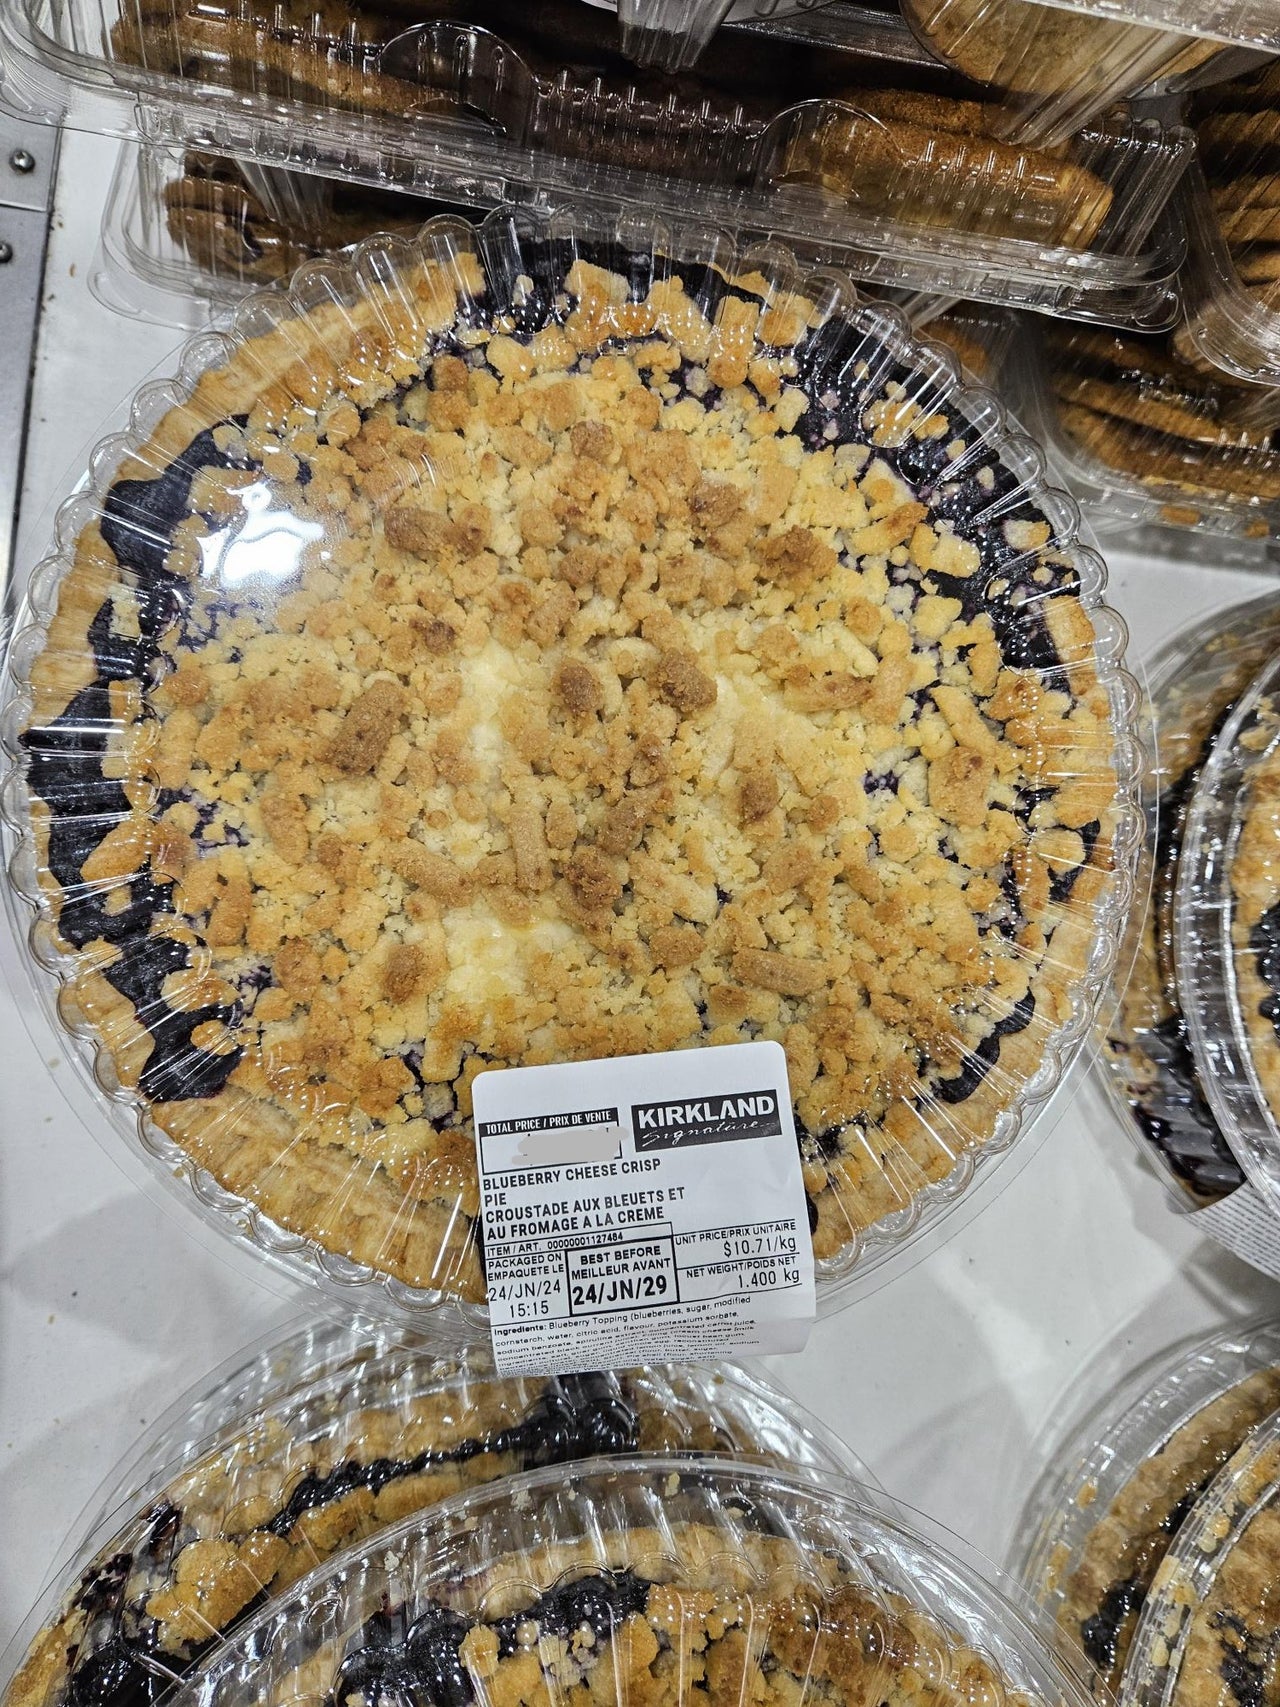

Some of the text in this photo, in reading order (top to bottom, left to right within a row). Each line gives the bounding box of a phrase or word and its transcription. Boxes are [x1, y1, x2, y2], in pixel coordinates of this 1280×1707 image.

[486, 1110, 611, 1134] TOTAL PRICE / PRIX DE VENTE
[638, 1096, 774, 1128] KIRKLAND
[642, 1120, 772, 1146] Signature
[483, 1158, 660, 1190] BLUEBERRY CHEESE CRISP
[485, 1193, 506, 1207] PIE
[486, 1187, 684, 1223] CROUSTADE AUX BLEUETS ET
[487, 1206, 664, 1240] AU FROMAGE A LA CREME
[676, 1222, 796, 1245] UNIT PRICE/PRIX UNITAIRE
[487, 1246, 510, 1257] ITEM
[518, 1242, 541, 1253] ART.
[580, 1246, 660, 1265] BEST BEFORE
[724, 1235, 796, 1258] $10.71/kg
[489, 1253, 562, 1269] PACKAGED ON
[571, 1258, 670, 1280] MEILLEUR AVANT
[687, 1256, 796, 1278] NET WEIGHT/POIDS NET
[488, 1264, 564, 1281] EMPAQUETE LE
[739, 1268, 799, 1288] 1.400 kg
[489, 1279, 560, 1301] 24/JN/24
[572, 1275, 667, 1305] 24/JN/29
[495, 1324, 547, 1336] Ingredients:
[549, 1318, 589, 1330] Blueberry
[593, 1313, 627, 1324] Topping
[714, 1297, 750, 1308] modified
[510, 1301, 549, 1318] 15:15
